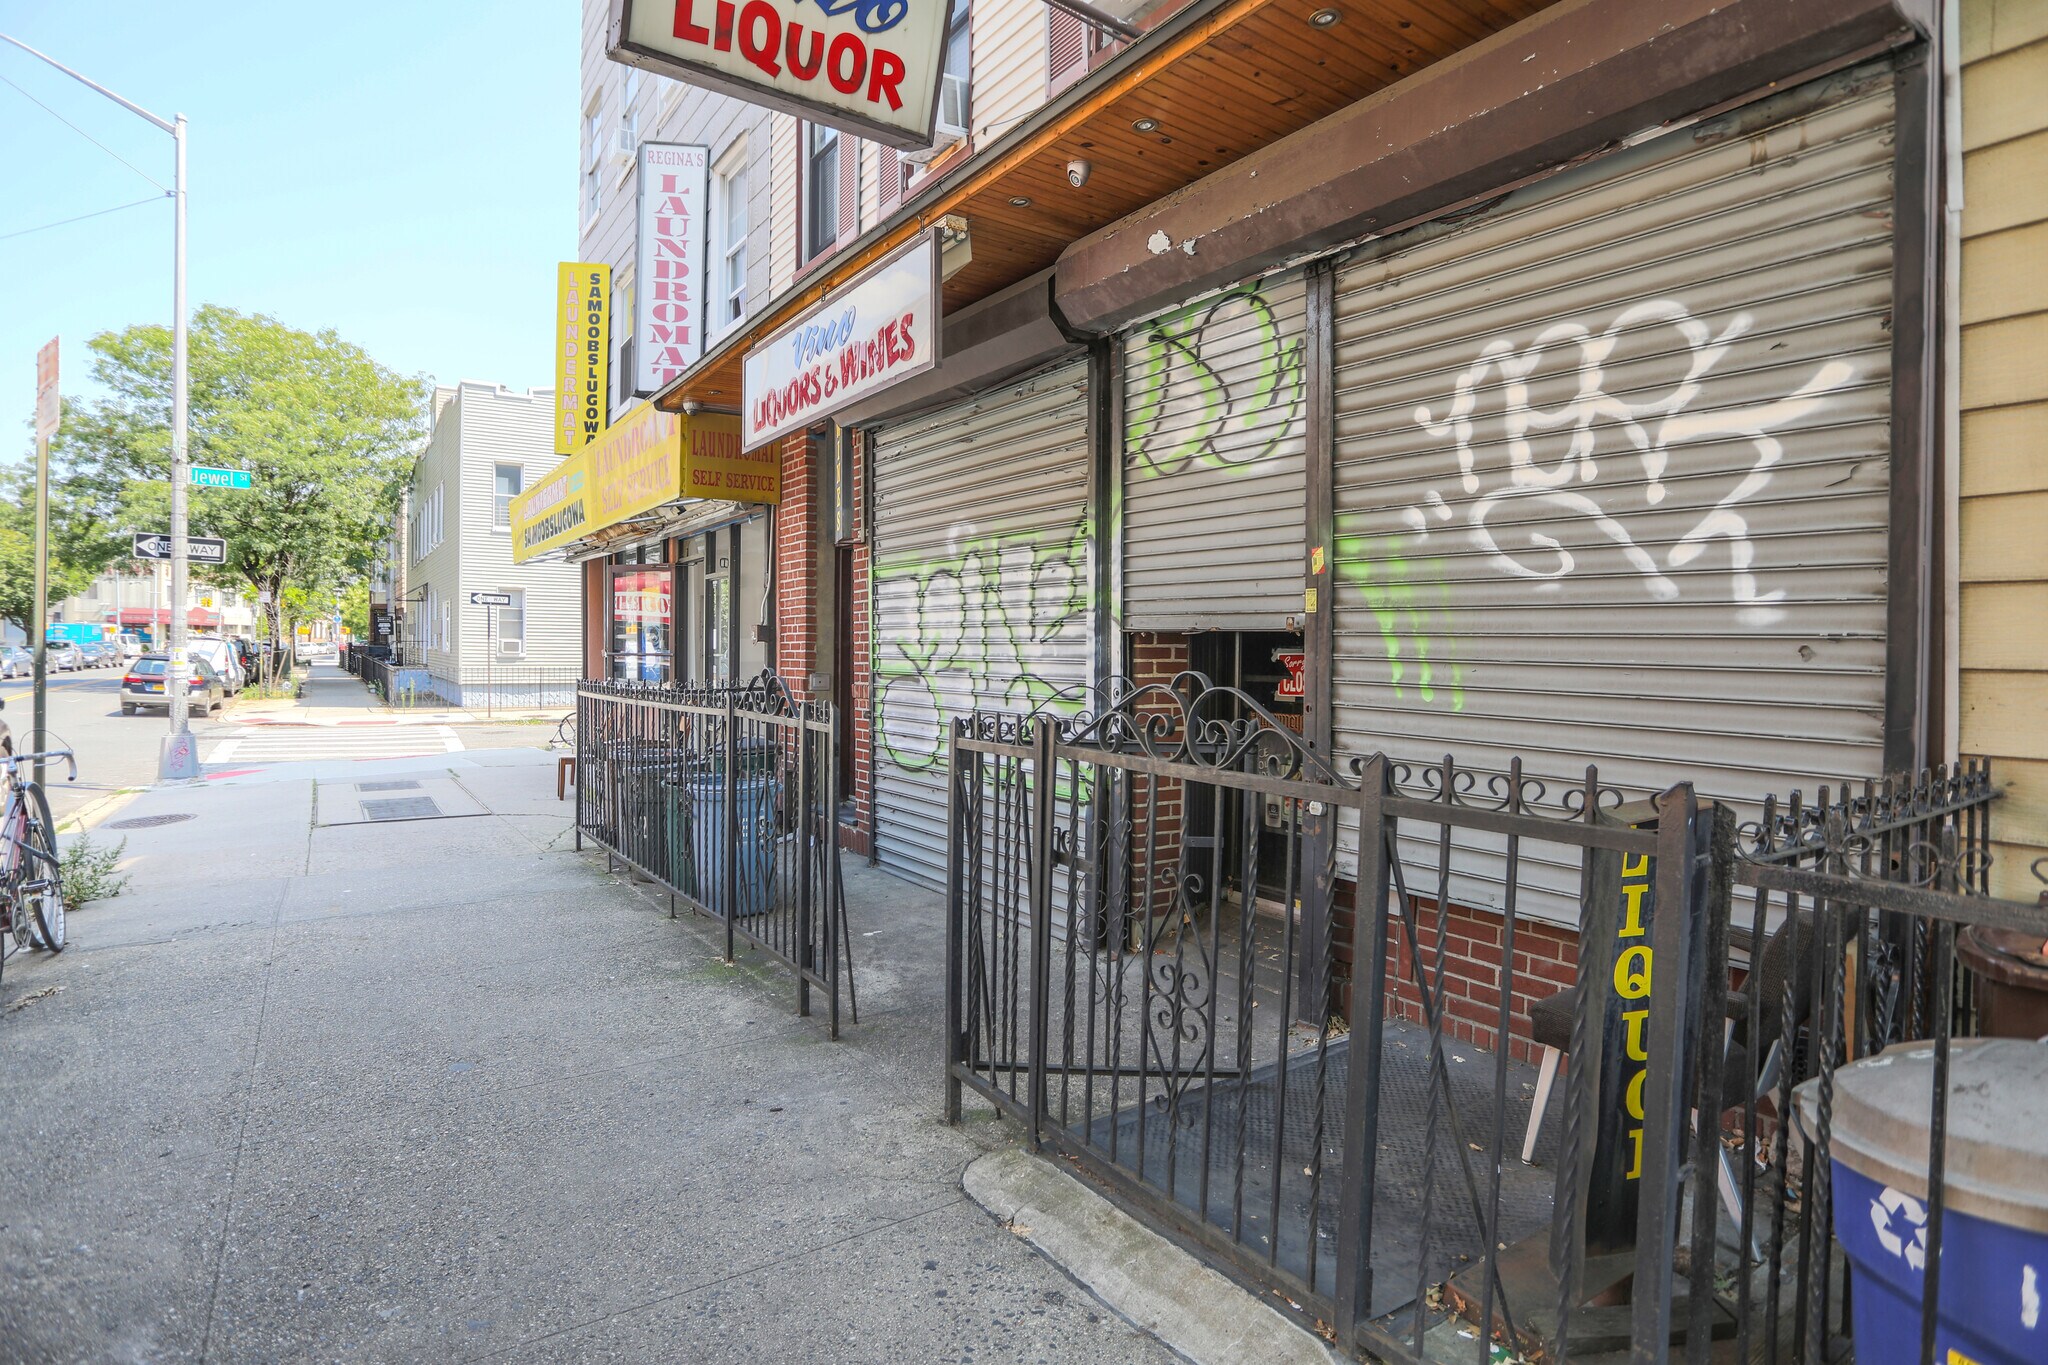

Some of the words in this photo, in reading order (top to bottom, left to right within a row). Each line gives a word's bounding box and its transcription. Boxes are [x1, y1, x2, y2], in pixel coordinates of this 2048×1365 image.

[673, 0, 905, 111] LIQUOR
[647, 150, 704, 168] REGINA'S
[649, 173, 692, 388] LAUNDROMAT
[562, 271, 580, 446] LAUNDERMAT
[753, 363, 822, 434] LIQUORS
[824, 363, 839, 399] &
[839, 312, 916, 390] WINES
[691, 429, 777, 464] LAUNDRMAT
[192, 469, 235, 486] Jewel
[239, 473, 249, 481] St
[601, 479, 624, 514] SELF
[627, 452, 672, 504] SERVICE
[692, 468, 722, 487] SELF
[725, 472, 775, 492] SERVICE
[147, 541, 172, 553] ONE
[189, 544, 217, 556] WAY
